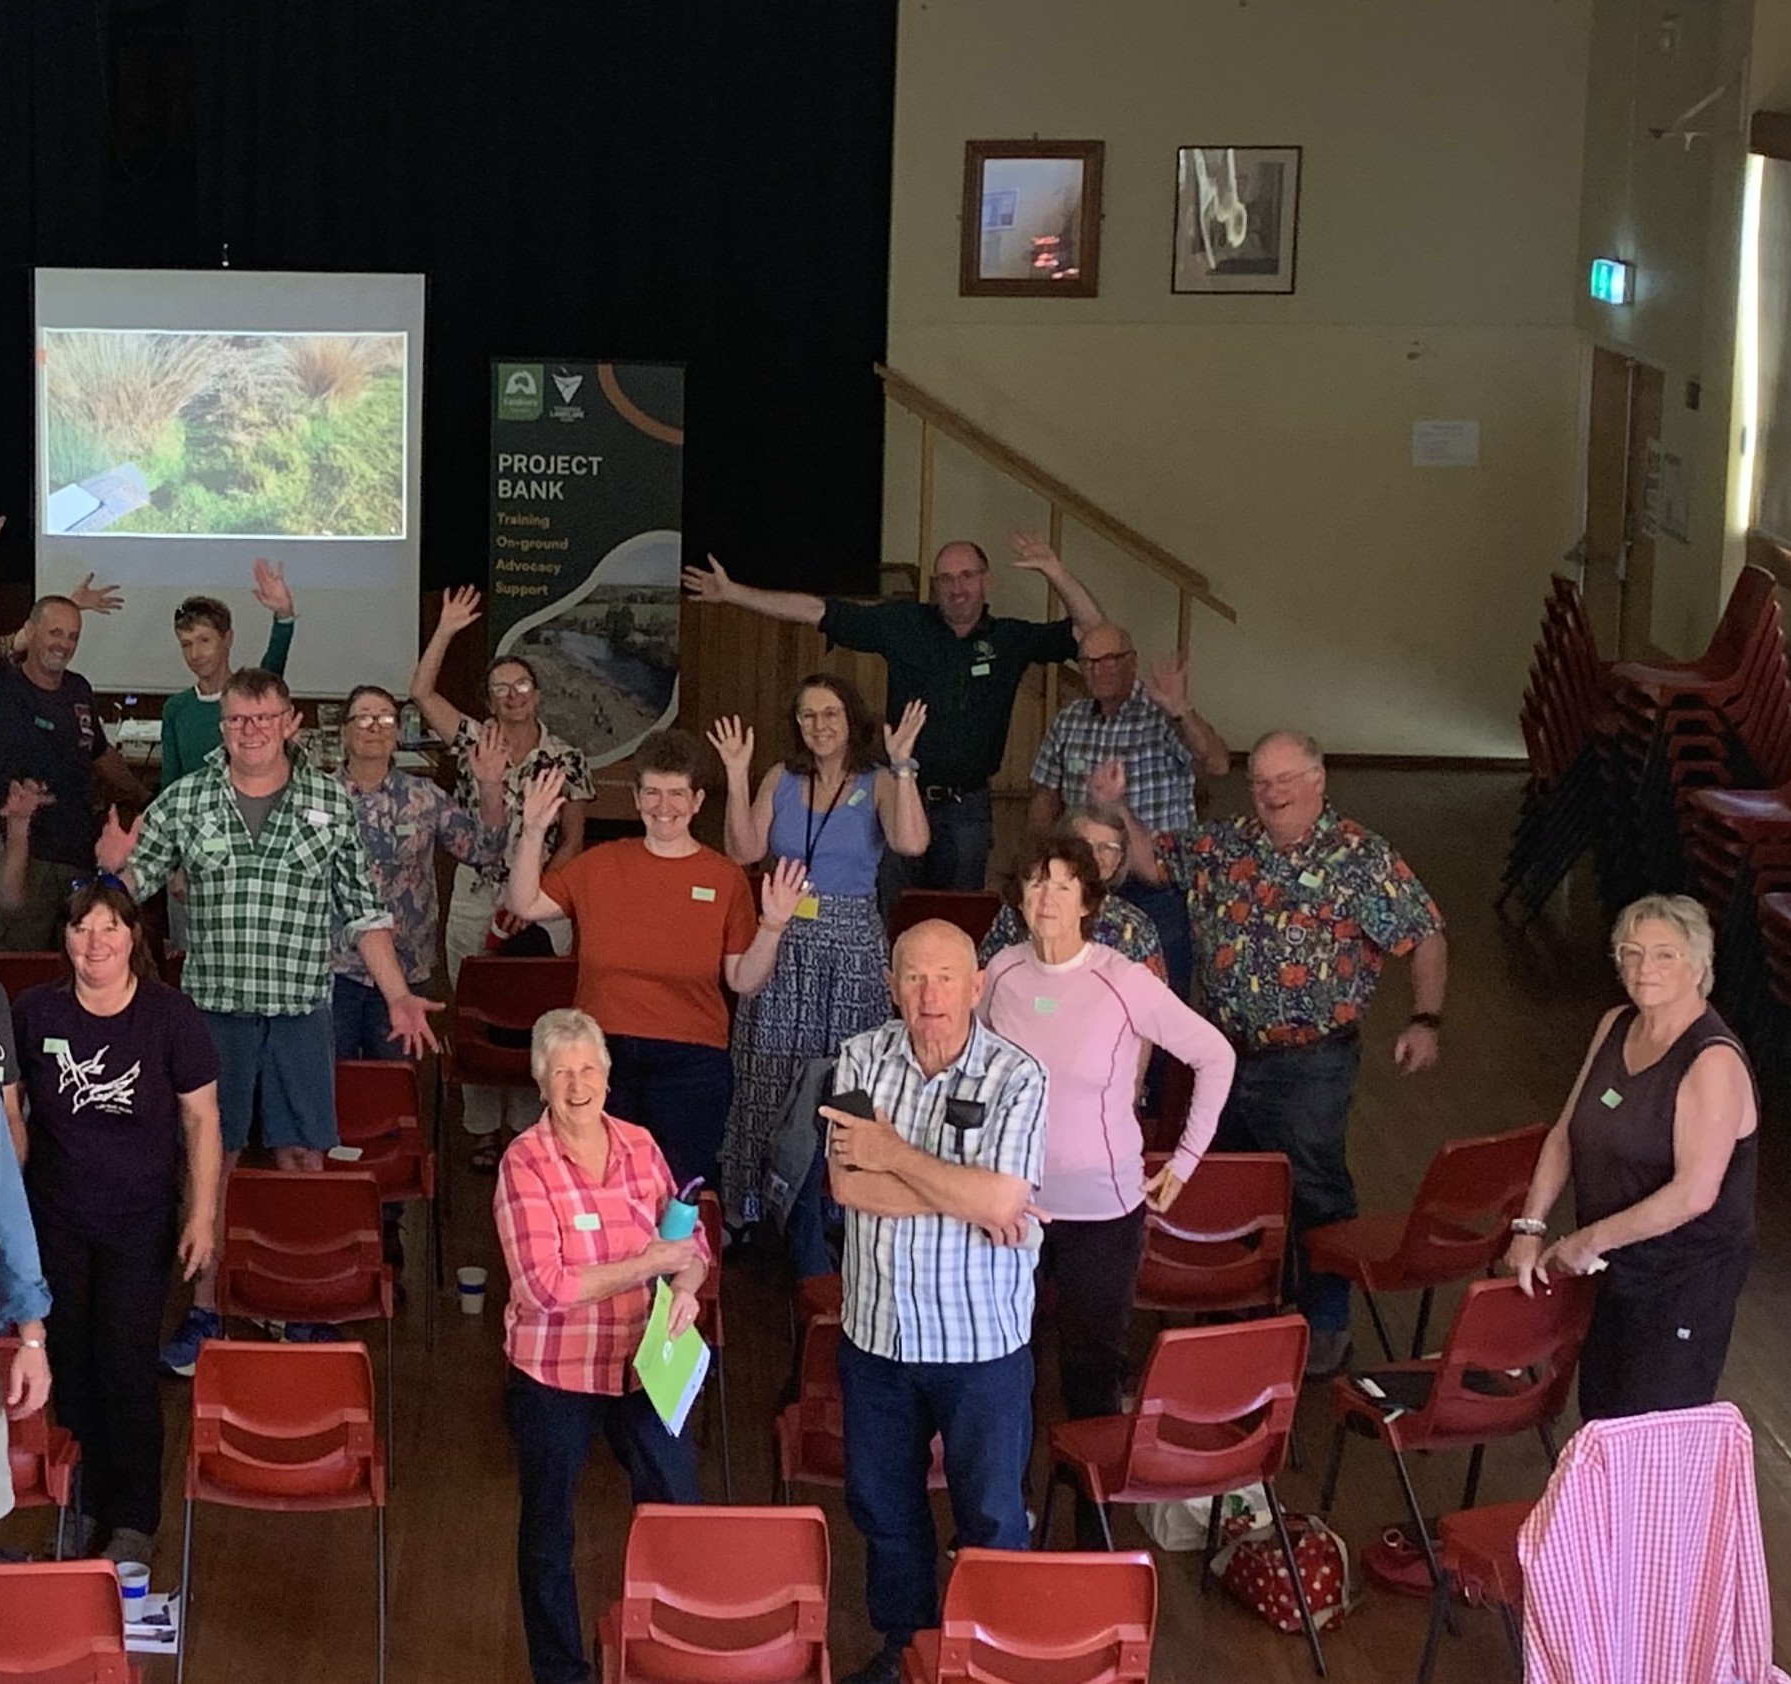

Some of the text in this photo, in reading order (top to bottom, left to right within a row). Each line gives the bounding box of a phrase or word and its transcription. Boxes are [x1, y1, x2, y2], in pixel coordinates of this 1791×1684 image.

[498, 453, 604, 477] PROJECT
[497, 478, 565, 501] BANK
[496, 511, 551, 530] Training
[495, 535, 569, 551] On-ground
[495, 558, 561, 575] Advocacy
[495, 581, 549, 597] Support
